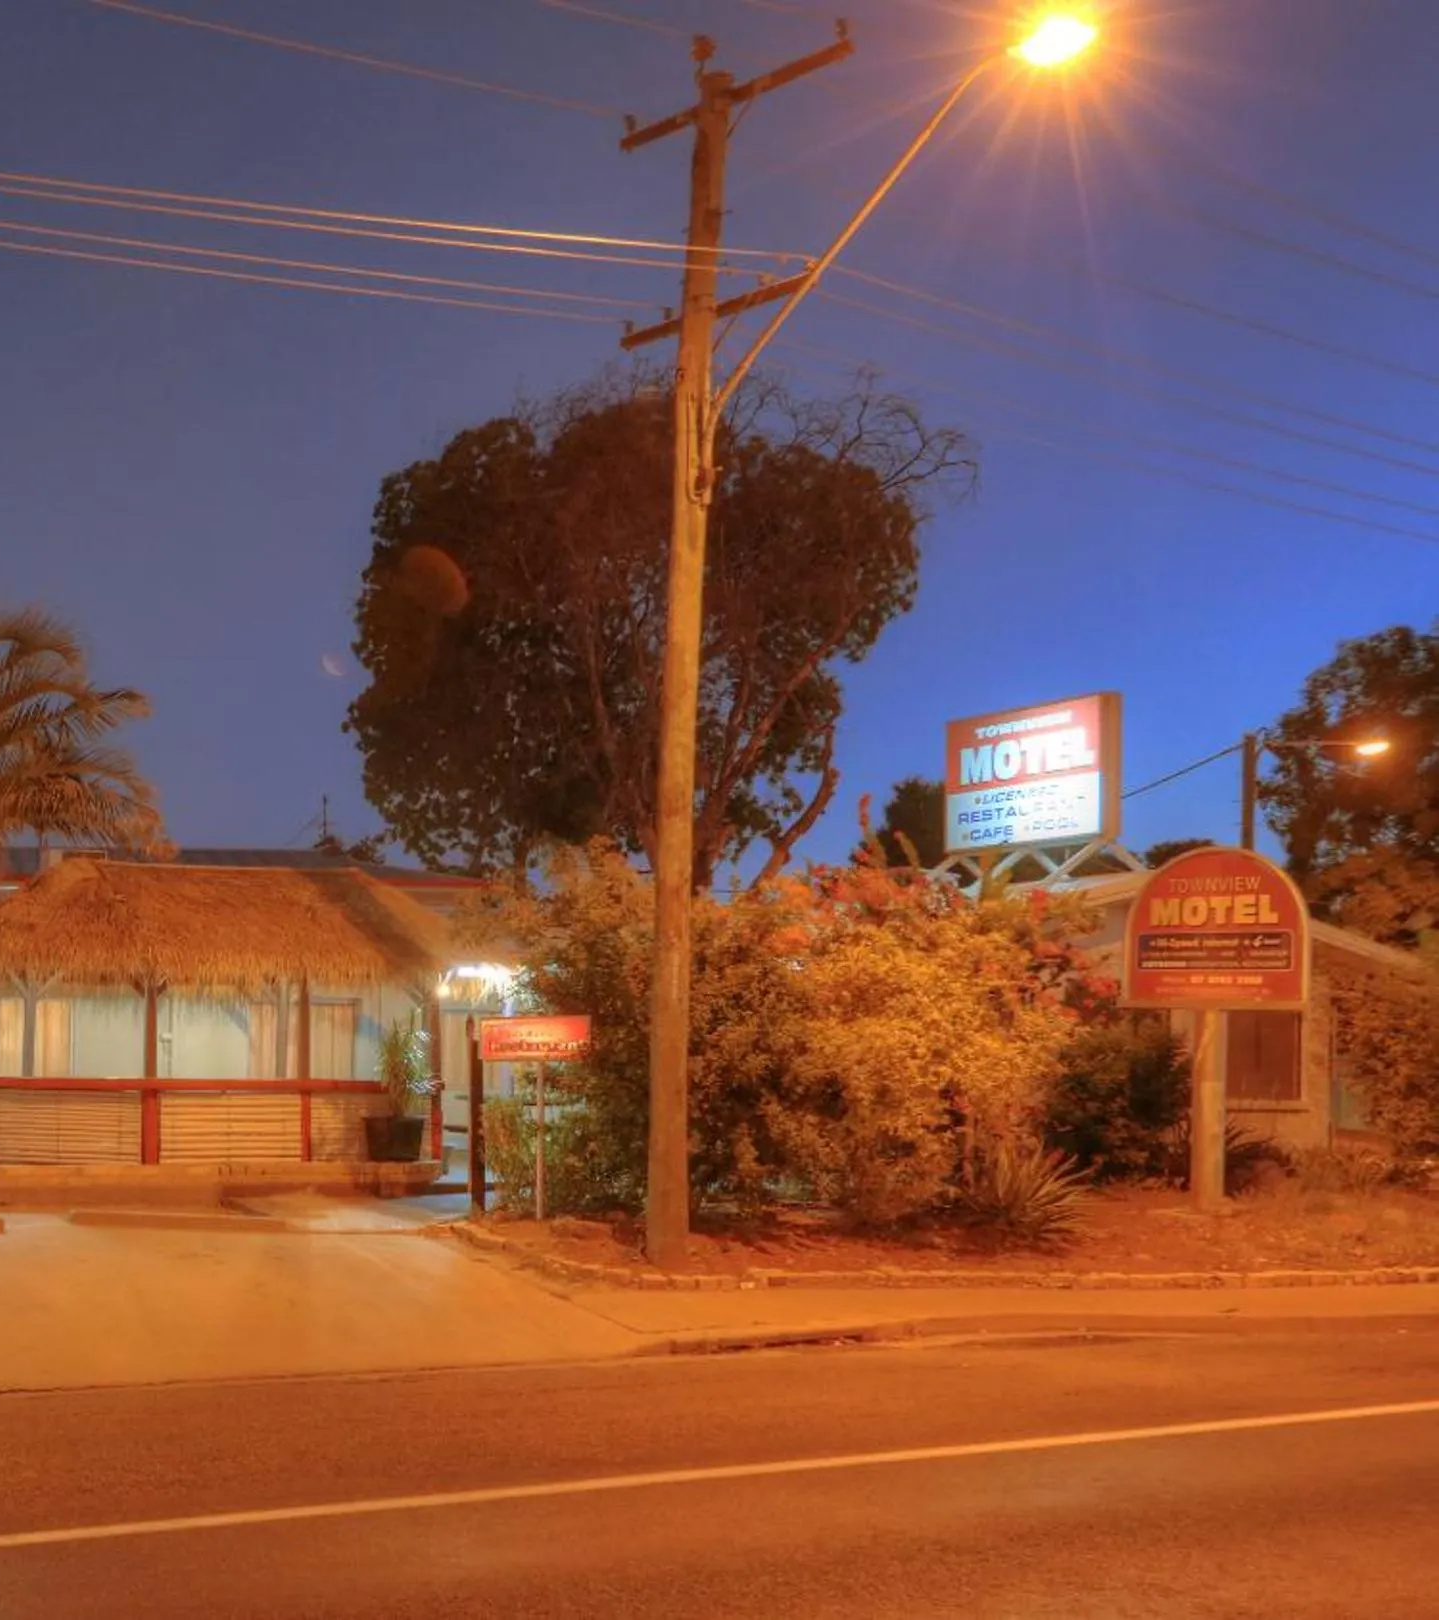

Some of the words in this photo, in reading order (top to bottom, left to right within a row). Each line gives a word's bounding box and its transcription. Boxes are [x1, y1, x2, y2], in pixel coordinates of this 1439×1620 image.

[974, 710, 1072, 739] TOWN
[960, 727, 1095, 785] MOTEL
[970, 824, 1015, 842] CAFE
[1168, 876, 1261, 893] TOWNVIEW
[1149, 894, 1279, 927] MOTEL
